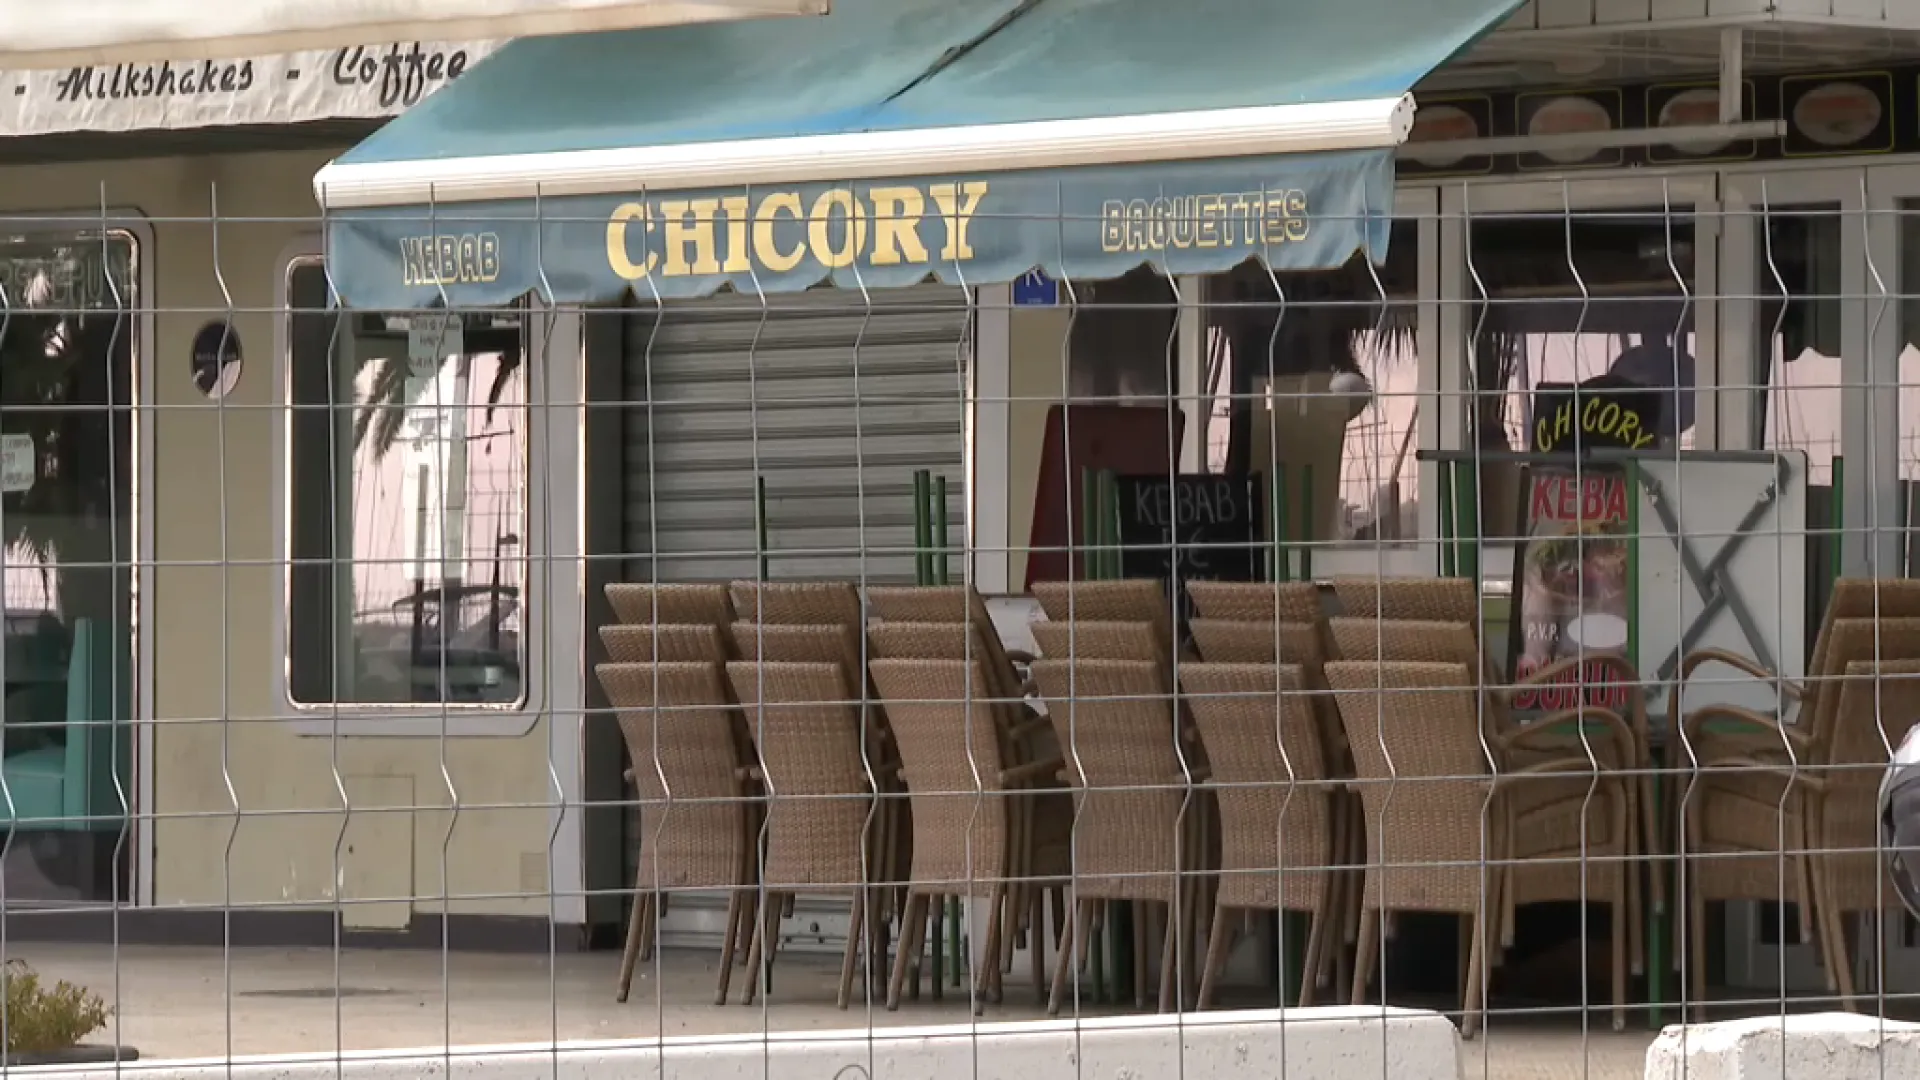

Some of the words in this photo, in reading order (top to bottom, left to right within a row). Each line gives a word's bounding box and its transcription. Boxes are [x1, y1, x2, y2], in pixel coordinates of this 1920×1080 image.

[57, 60, 255, 101] Milkshakes
[333, 40, 467, 108] Coffee
[606, 181, 987, 280] CHICORY
[1102, 190, 1309, 252] BAGUETTES
[401, 231, 500, 286] KEBAB
[1536, 396, 1654, 452] CHCORY
[1135, 479, 1236, 525] KEBAB
[1531, 473, 1628, 521] KEBA
